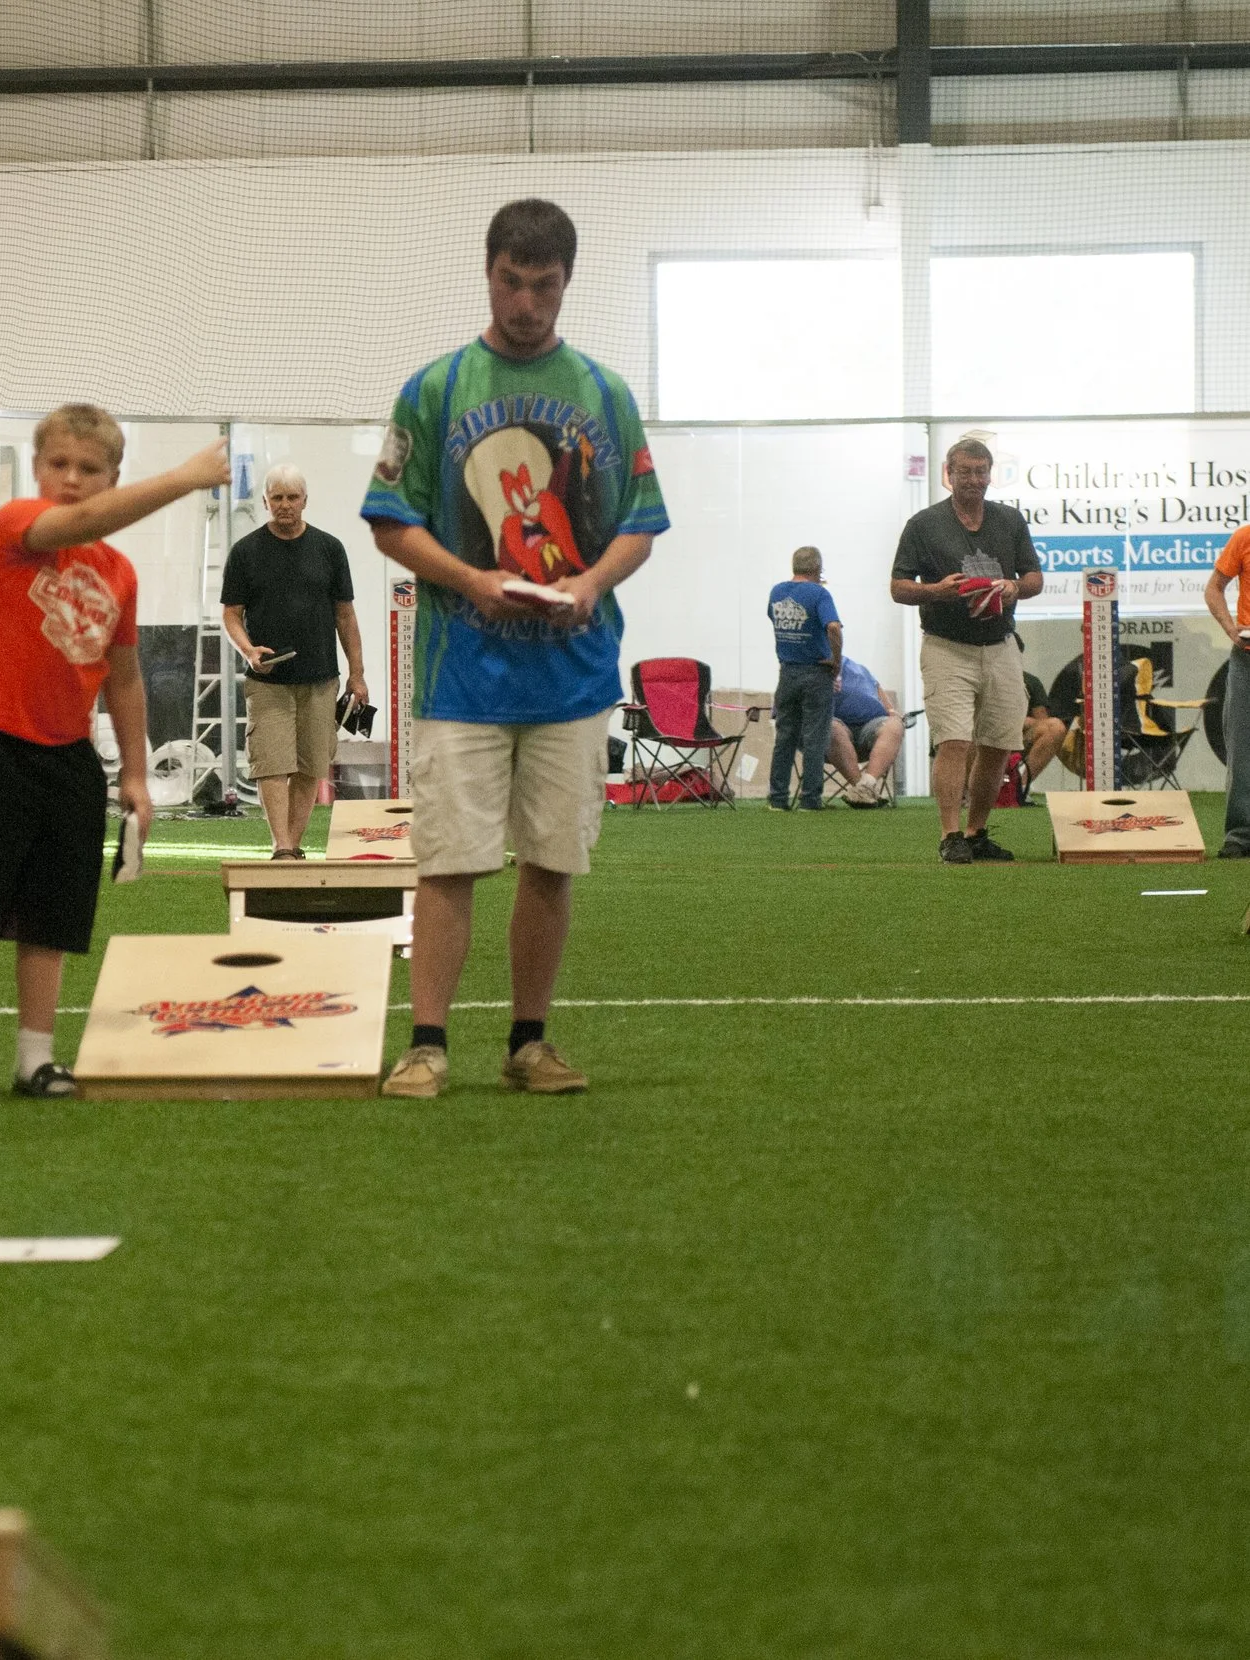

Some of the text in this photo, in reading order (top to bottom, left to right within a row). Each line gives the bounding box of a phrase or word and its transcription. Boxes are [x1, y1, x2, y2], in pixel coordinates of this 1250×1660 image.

[1027, 461, 1250, 490] Children's Hos
[1062, 499, 1148, 531] King's
[1036, 542, 1114, 571] Sports
[1153, 578, 1175, 596] for
[1178, 577, 1206, 594] You
[775, 620, 805, 630] LIGHT
